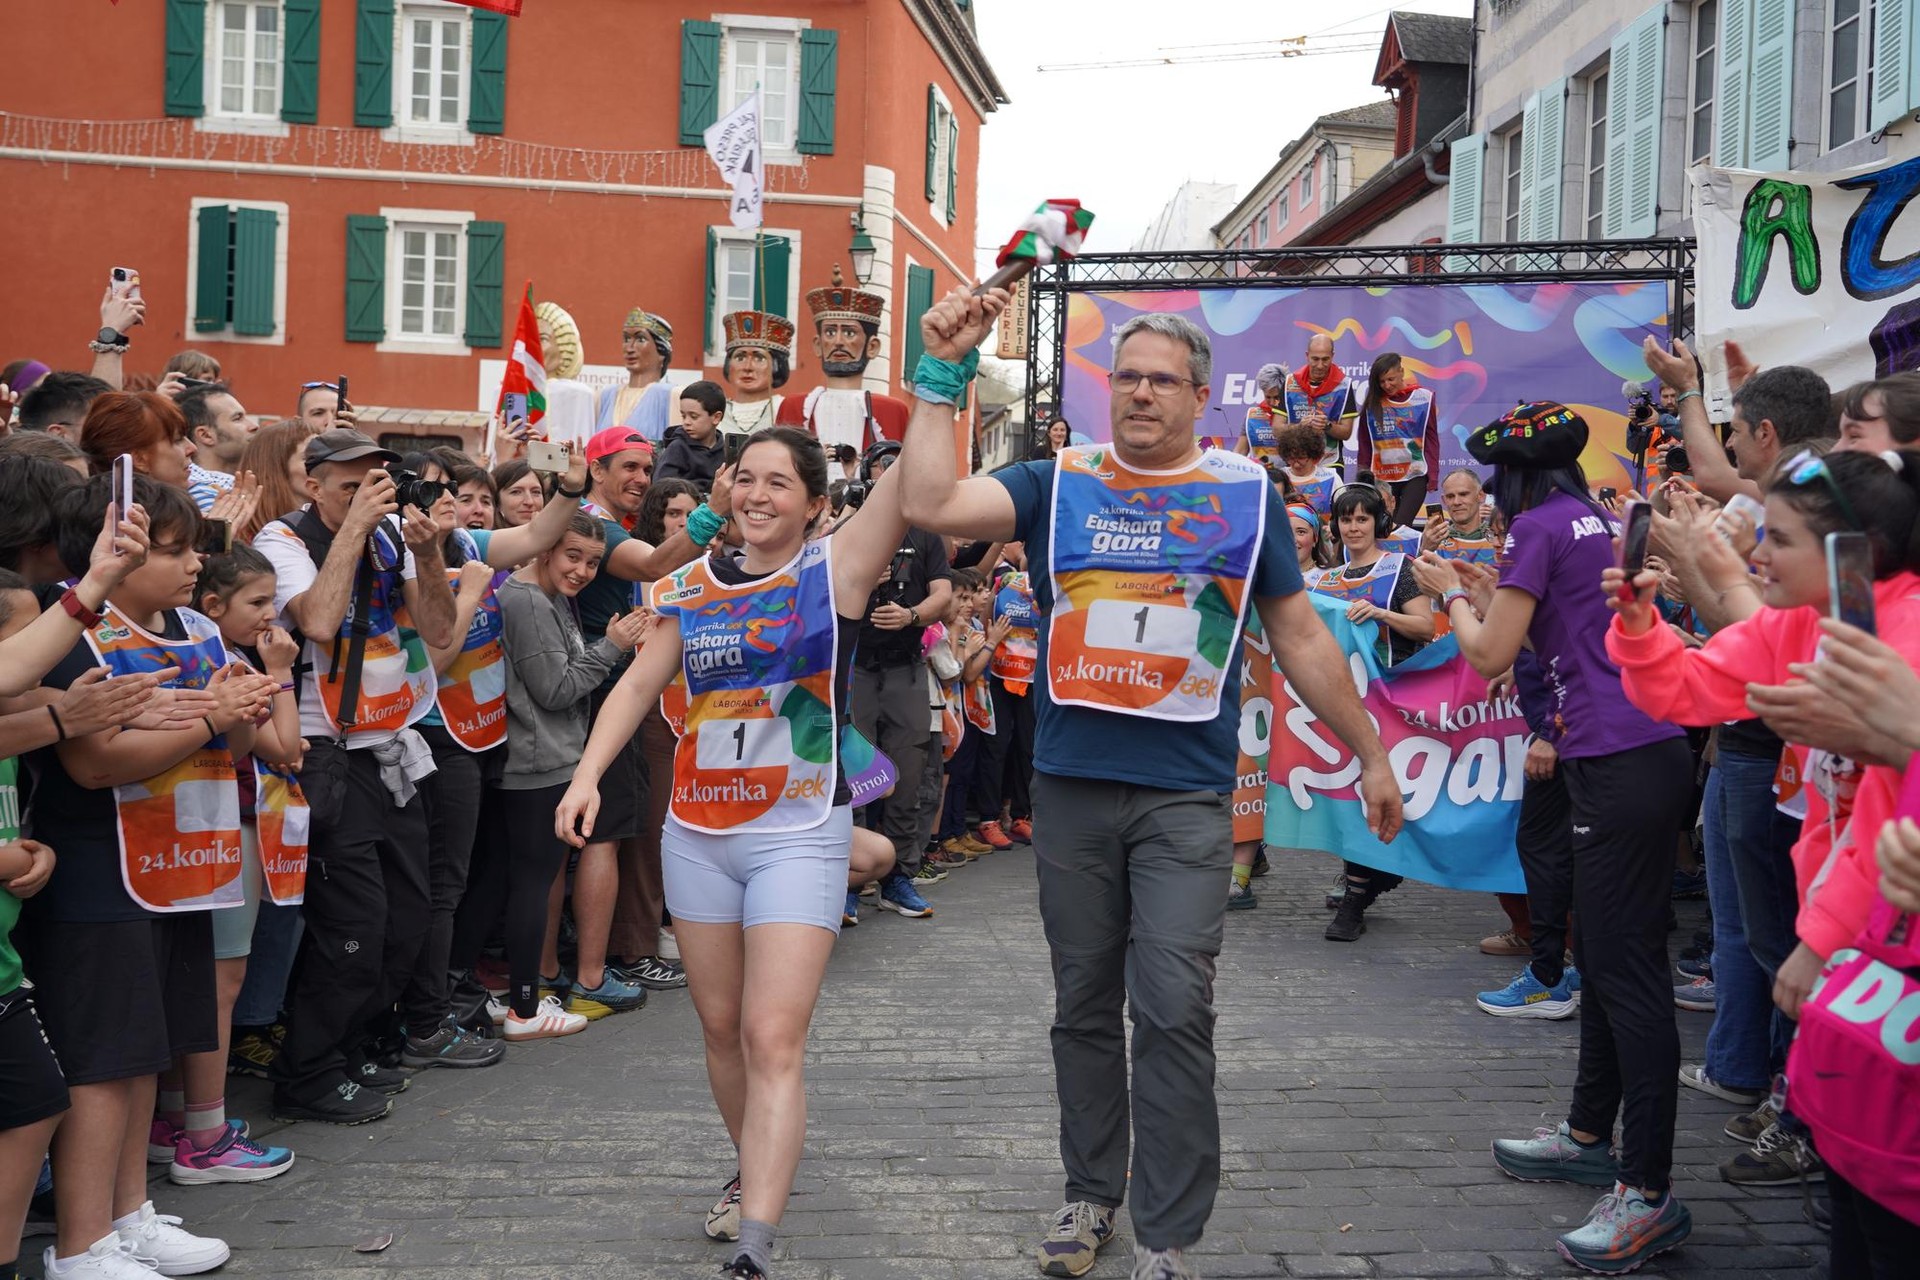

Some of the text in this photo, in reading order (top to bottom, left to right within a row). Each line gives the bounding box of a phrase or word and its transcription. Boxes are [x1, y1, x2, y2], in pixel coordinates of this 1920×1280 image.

[1002, 308, 1012, 352] ERIE
[1016, 280, 1026, 354] RCUTERIE
[1226, 464, 1260, 475] eitb
[1085, 514, 1162, 534] Euskara
[1091, 532, 1162, 553] gara
[1115, 582, 1161, 592] LABORAL
[1134, 607, 1149, 643] 1
[688, 646, 743, 673] gara
[1056, 656, 1218, 699] 24.korrika aek
[713, 699, 752, 708] LABORAL
[732, 722, 747, 761] 1
[675, 770, 827, 803] 24.korrika aek
